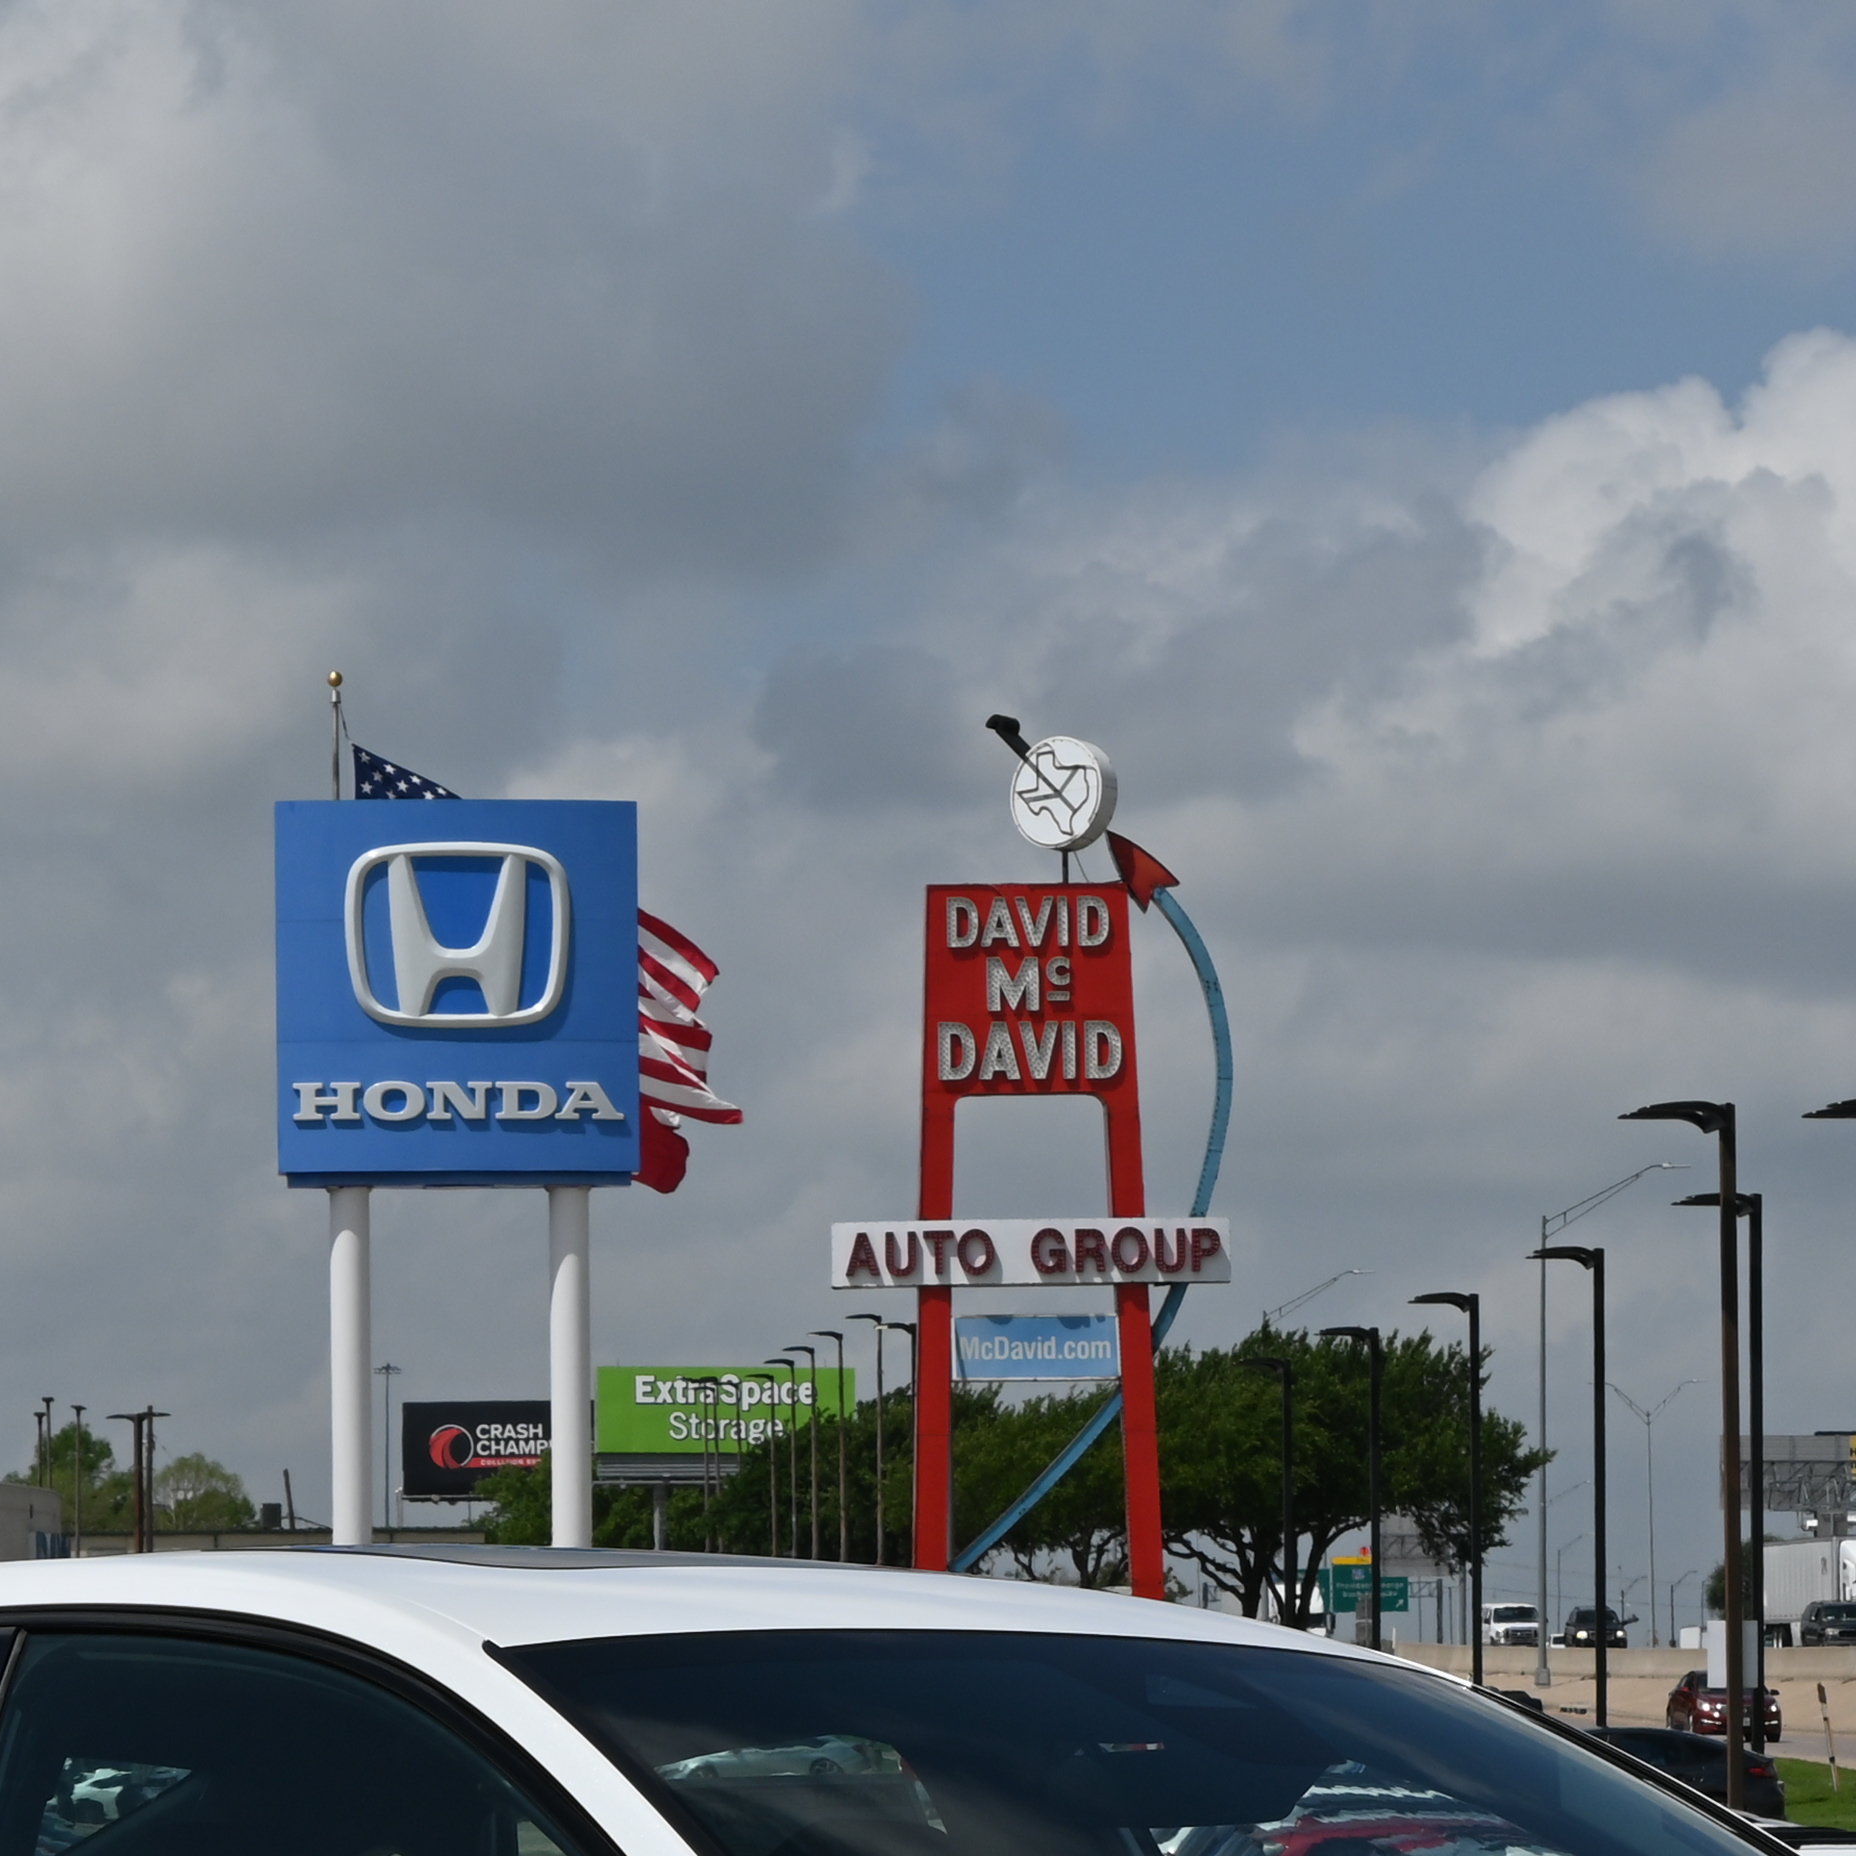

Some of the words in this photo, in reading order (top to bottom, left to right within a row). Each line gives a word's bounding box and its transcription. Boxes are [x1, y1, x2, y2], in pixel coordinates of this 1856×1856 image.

[946, 896, 1110, 948] DAVID
[986, 955, 1071, 1012] Mc
[937, 1020, 1123, 1081] DAVID
[292, 1081, 625, 1122] HONDA
[846, 1228, 996, 1276] AUTO
[1030, 1226, 1221, 1274] GROUP
[959, 1335, 1112, 1361] McDavid.com
[476, 1424, 543, 1439] CRASH
[476, 1440, 552, 1456] CHAMP
[669, 1411, 784, 1445] Storage
